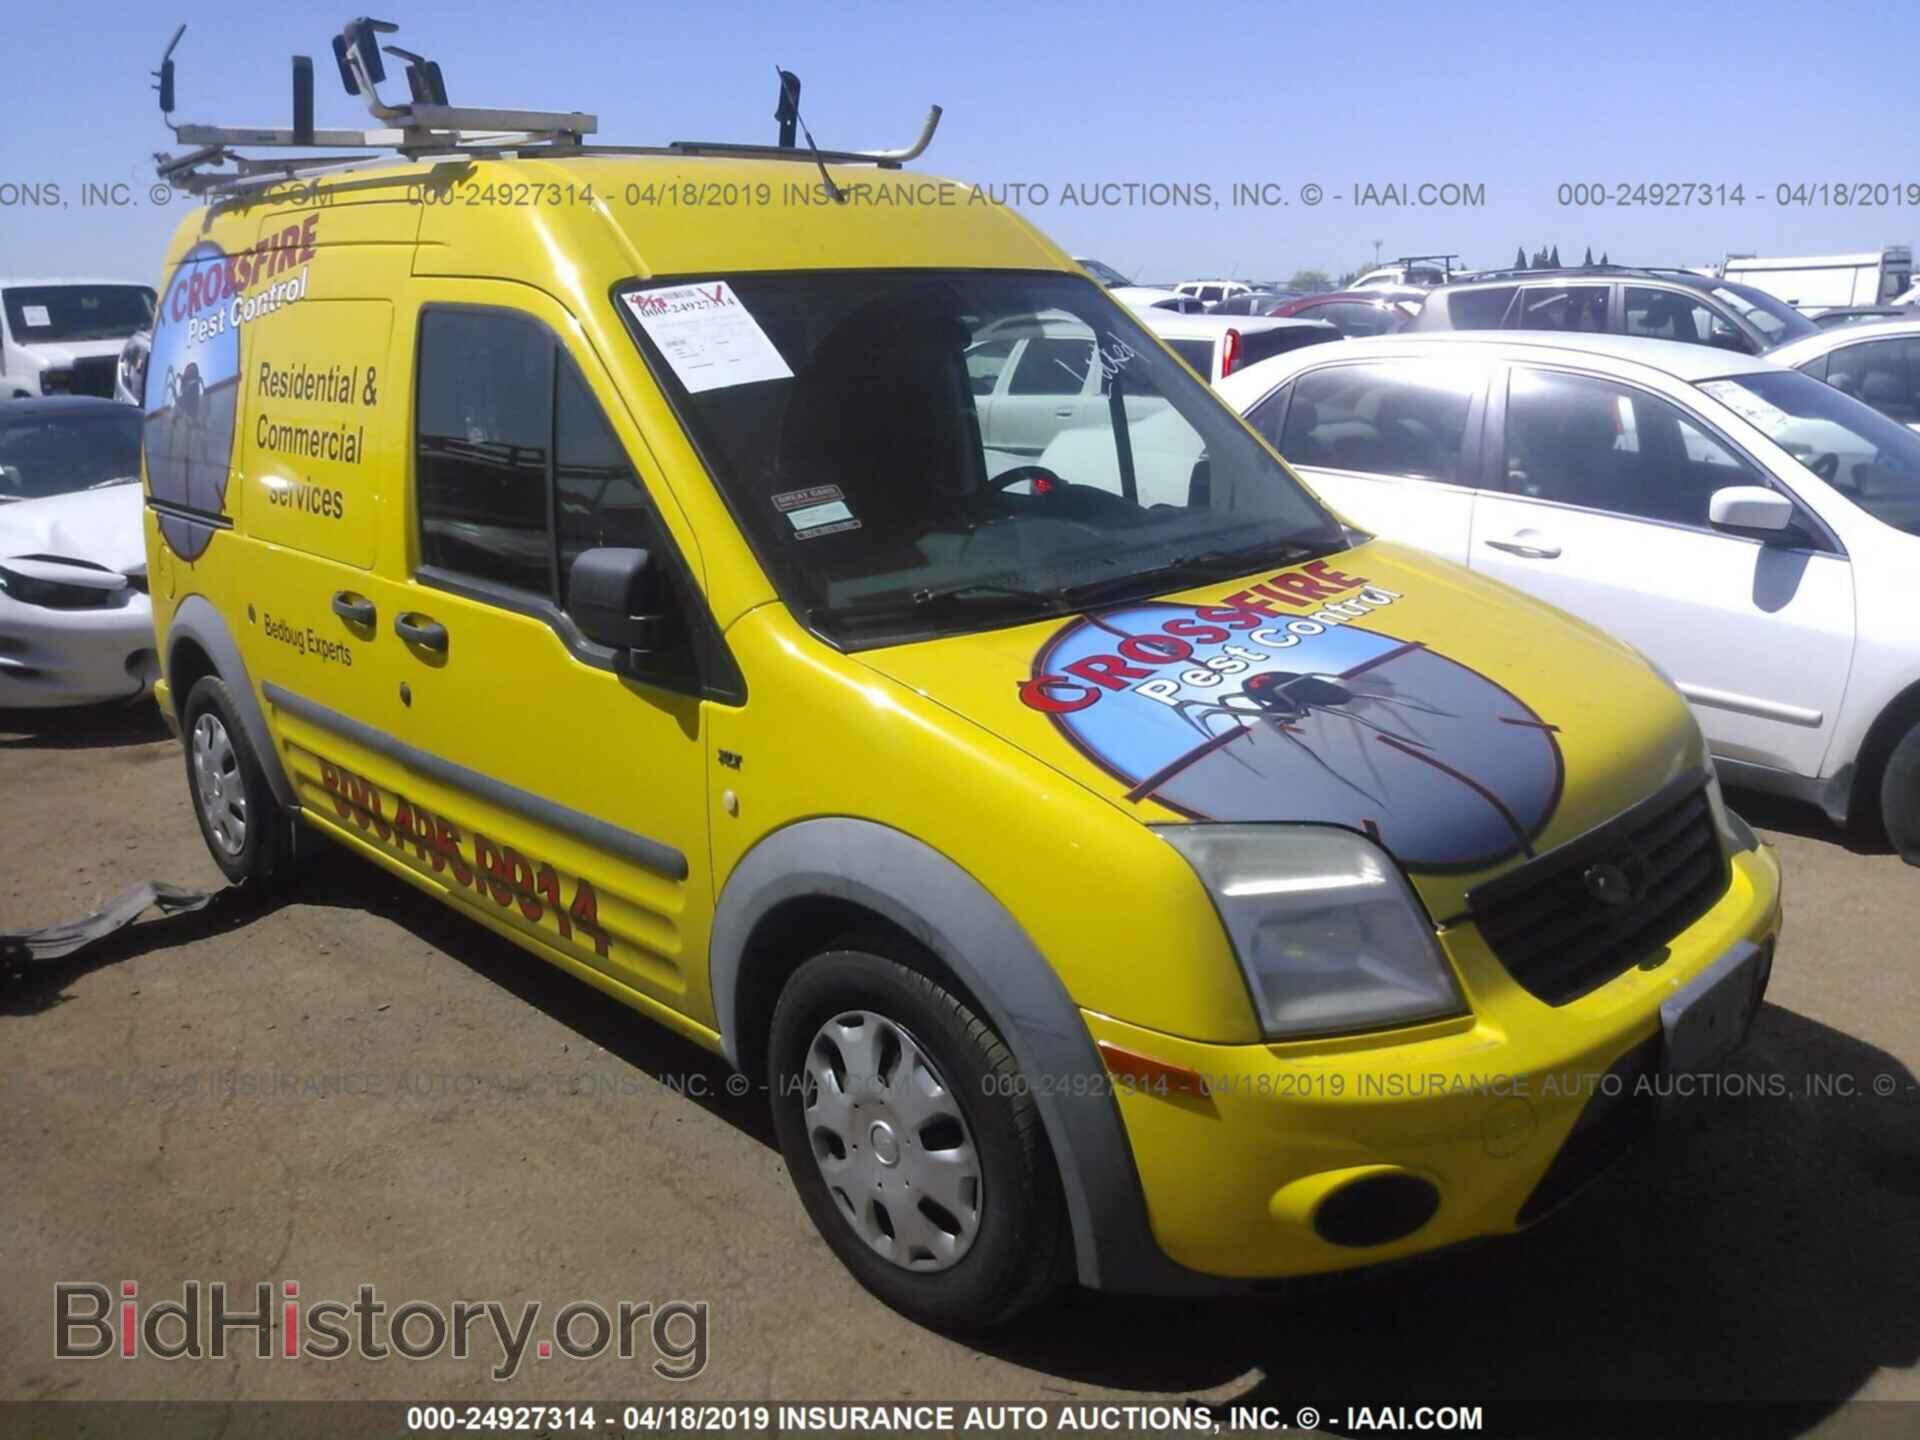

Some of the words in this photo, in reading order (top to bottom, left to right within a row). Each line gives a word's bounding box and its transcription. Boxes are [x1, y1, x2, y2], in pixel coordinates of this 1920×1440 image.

[171, 213, 320, 322] CROSSFIRE
[186, 309, 226, 347] Pest
[229, 266, 309, 328] Control
[258, 361, 358, 405] Residential
[362, 366, 377, 406] &
[256, 413, 364, 464] Commercial
[269, 475, 344, 519] services
[263, 612, 305, 655] Bedbug
[306, 627, 352, 667] Experts
[1018, 559, 1367, 714] CROSSFIRE
[1131, 642, 1271, 707] Pest
[1249, 584, 1402, 648] Control
